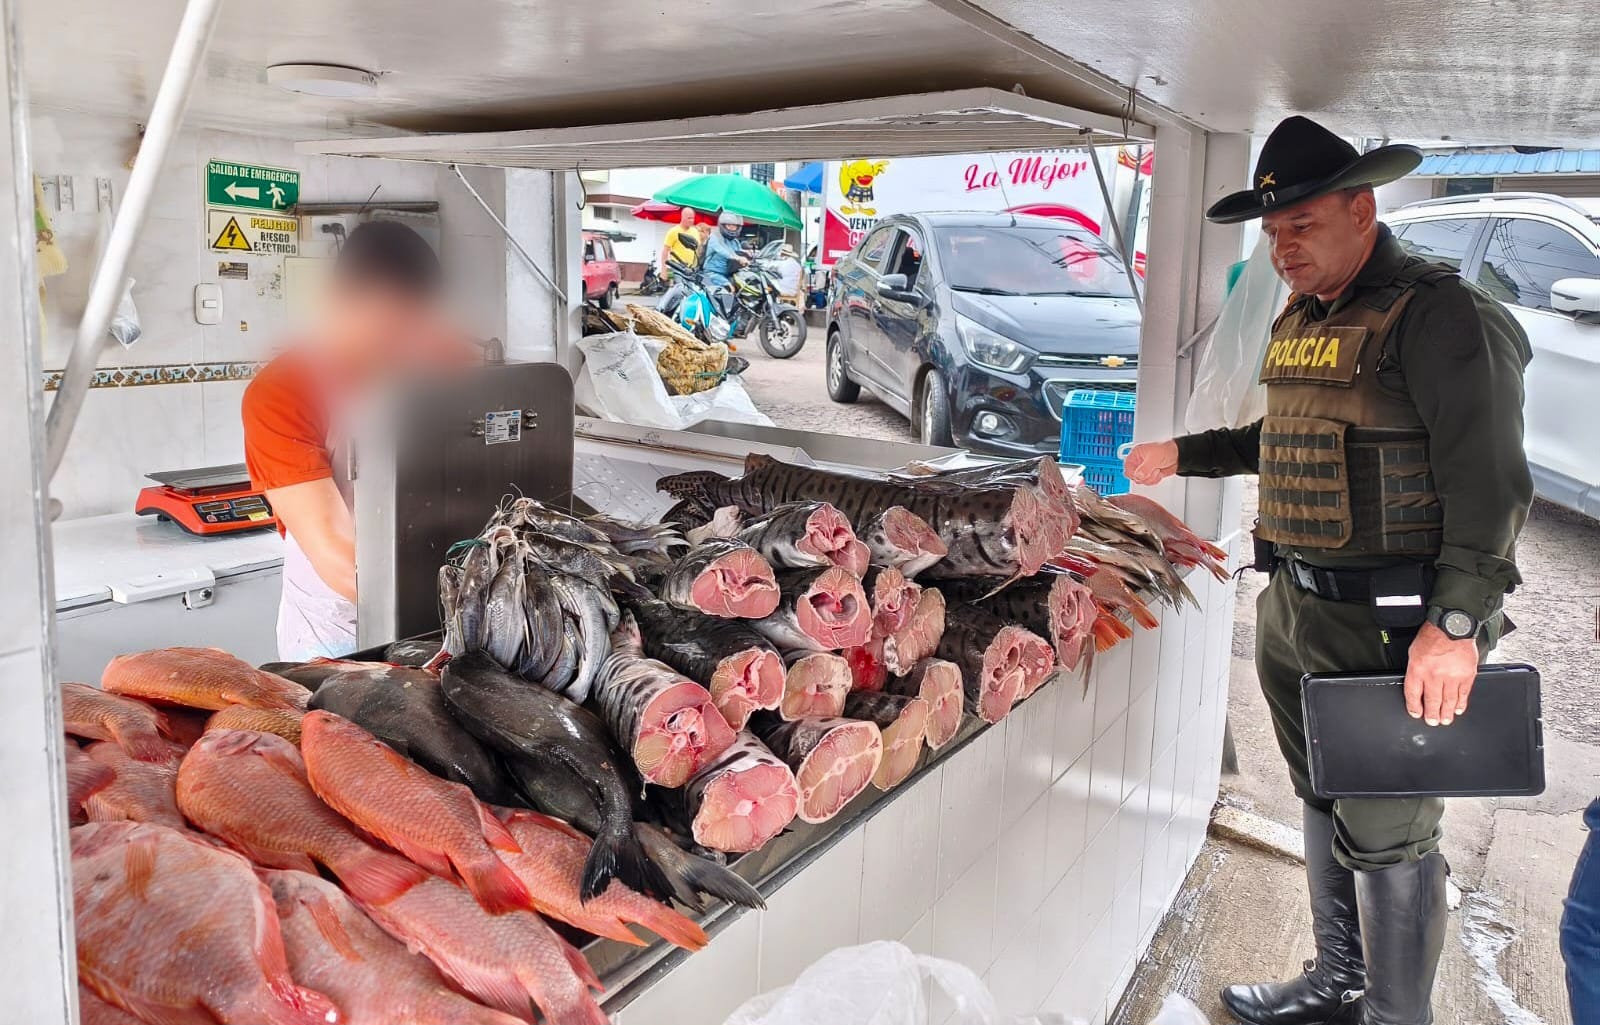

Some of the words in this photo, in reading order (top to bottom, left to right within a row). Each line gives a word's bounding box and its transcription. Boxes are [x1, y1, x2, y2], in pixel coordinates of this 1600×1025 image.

[210, 163, 238, 177] SALIDA
[240, 166, 249, 178] DE
[251, 168, 297, 184] EMERGENCIA
[964, 164, 999, 191] La
[1008, 156, 1087, 190] Mejor
[251, 217, 296, 232] PELIGRO
[260, 231, 289, 243] RIESGO
[254, 241, 296, 254] ELECTRICO
[1265, 336, 1340, 368] POLICIA
